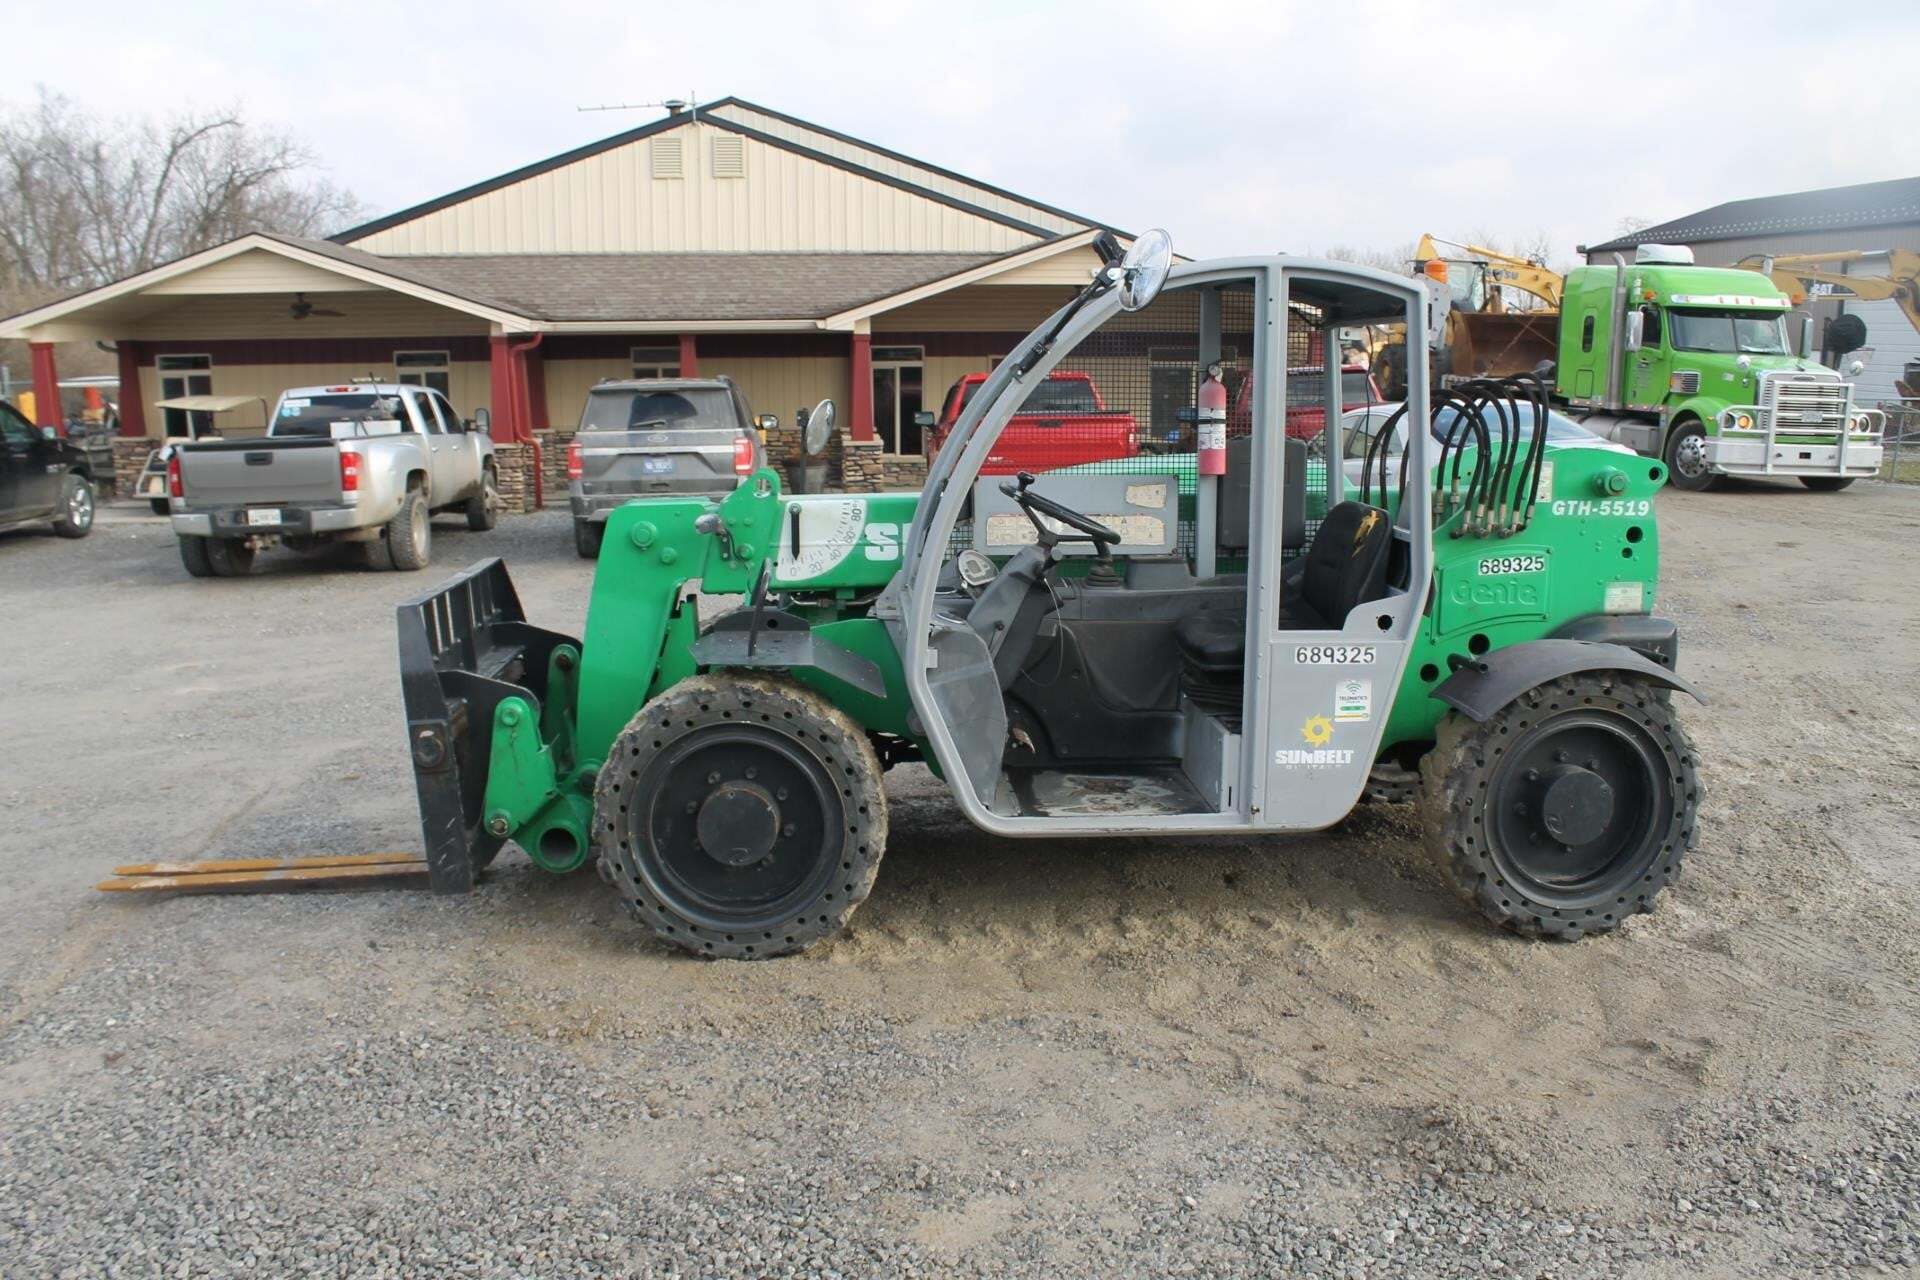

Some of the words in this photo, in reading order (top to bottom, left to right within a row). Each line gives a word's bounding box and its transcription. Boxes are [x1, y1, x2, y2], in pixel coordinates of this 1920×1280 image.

[1552, 501, 1650, 517] GTH-5519
[1480, 557, 1544, 574] 689325
[1451, 578, 1539, 606] Genie
[1296, 646, 1375, 664] 689325
[1274, 749, 1355, 764] SUNBELT
